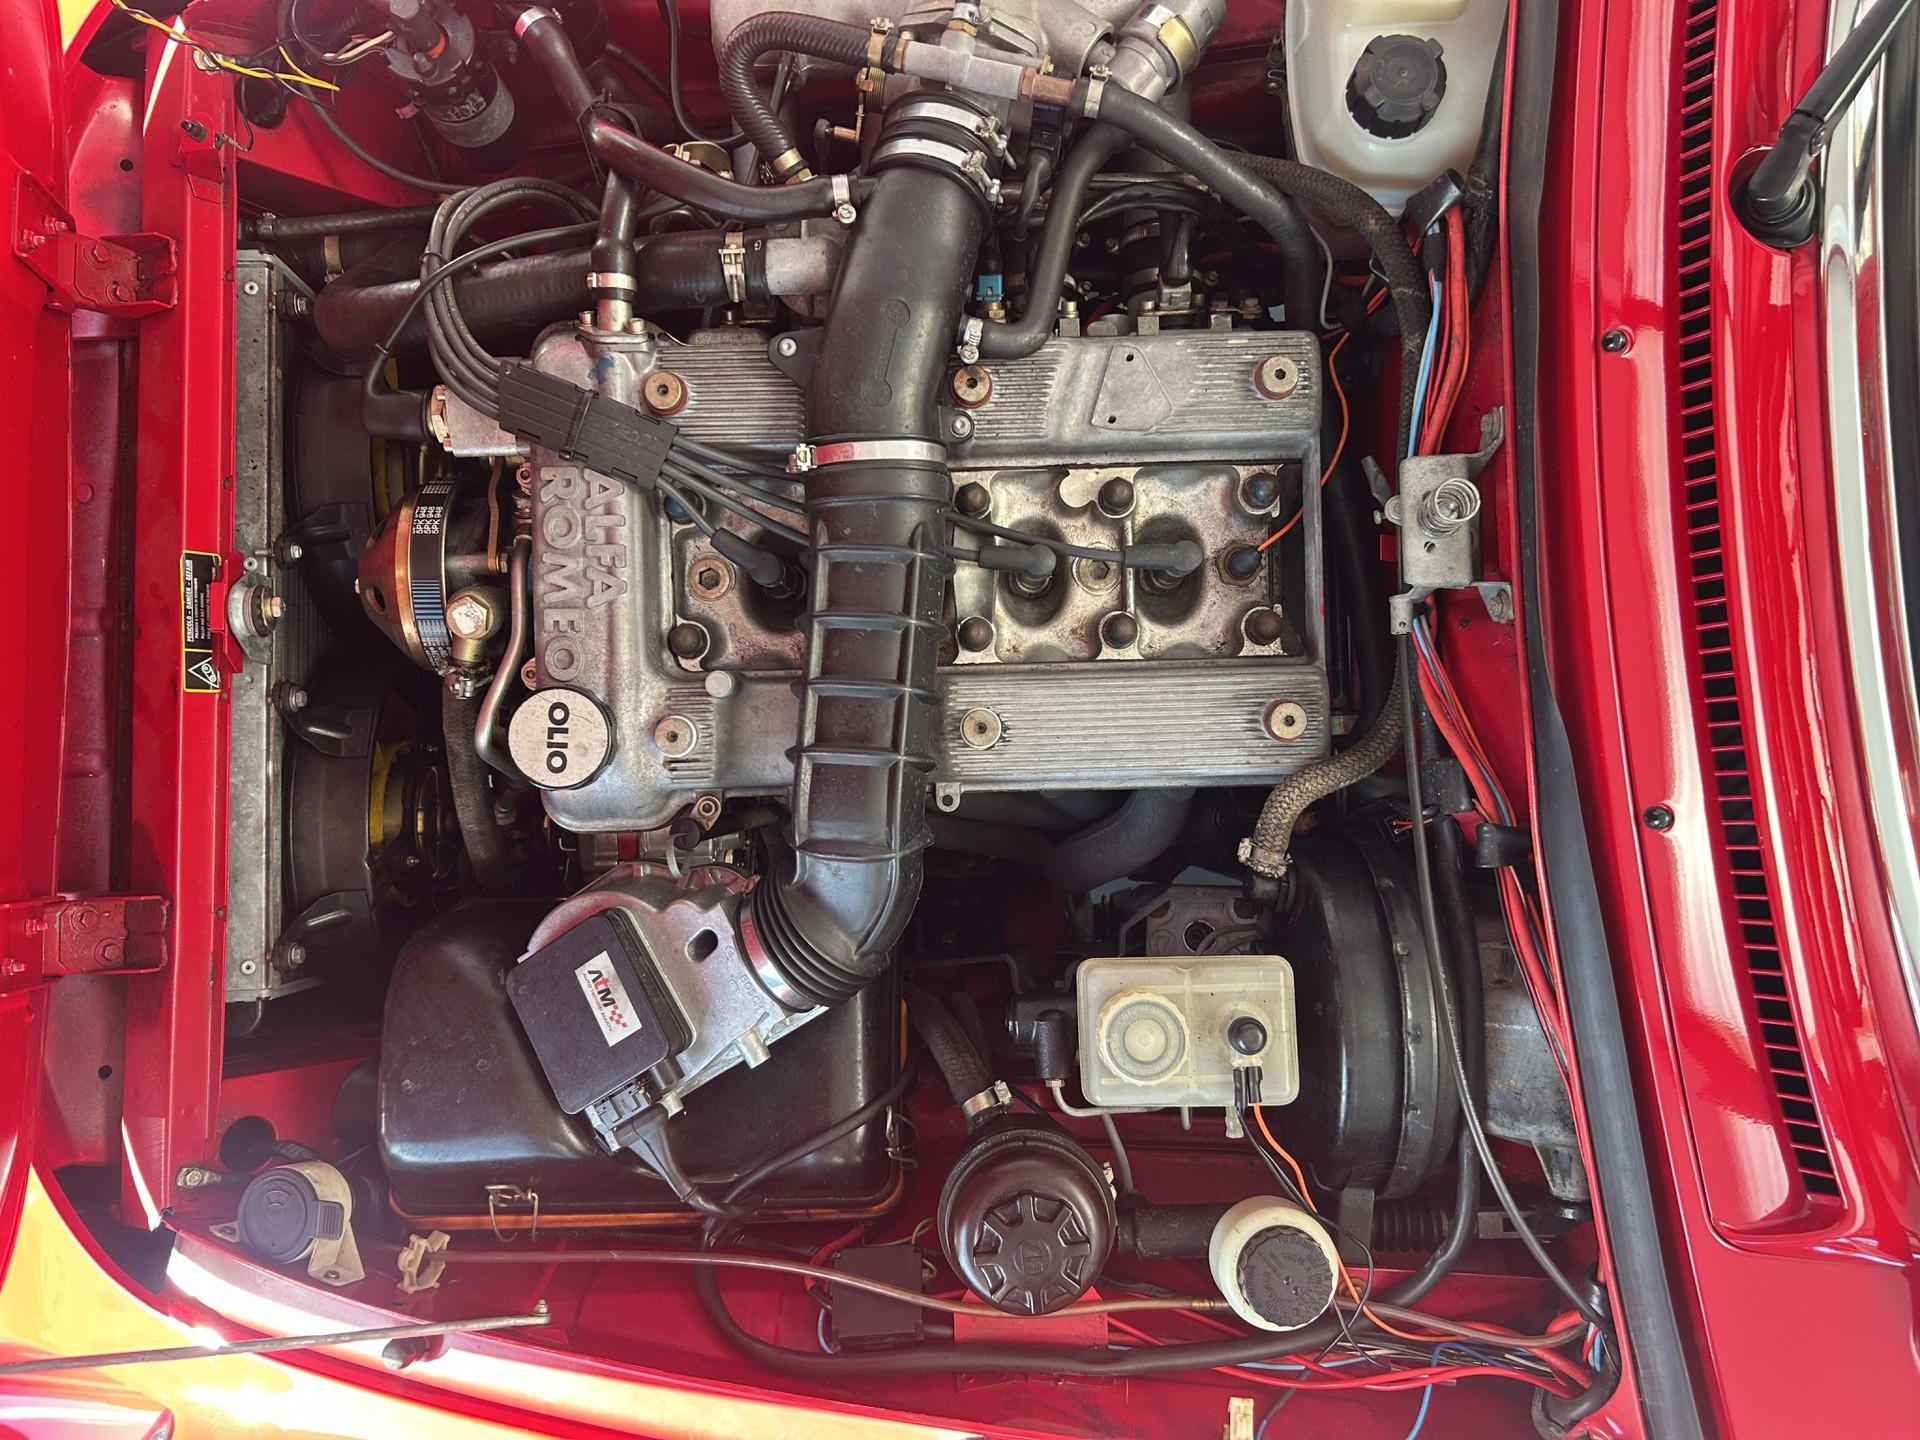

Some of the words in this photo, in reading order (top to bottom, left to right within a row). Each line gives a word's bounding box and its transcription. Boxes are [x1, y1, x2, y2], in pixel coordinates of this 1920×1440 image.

[416, 519, 425, 535] 5PK
[423, 519, 433, 535] 5PK
[583, 468, 628, 609] ALFA
[539, 465, 584, 683] ROMEO
[185, 587, 193, 610] DANGER
[185, 615, 193, 643] PERICOLO
[546, 701, 570, 774] OLIO
[582, 972, 593, 989] AUTO
[601, 1011, 613, 1033] MARTY
[739, 974, 765, 1012] BOSCH
